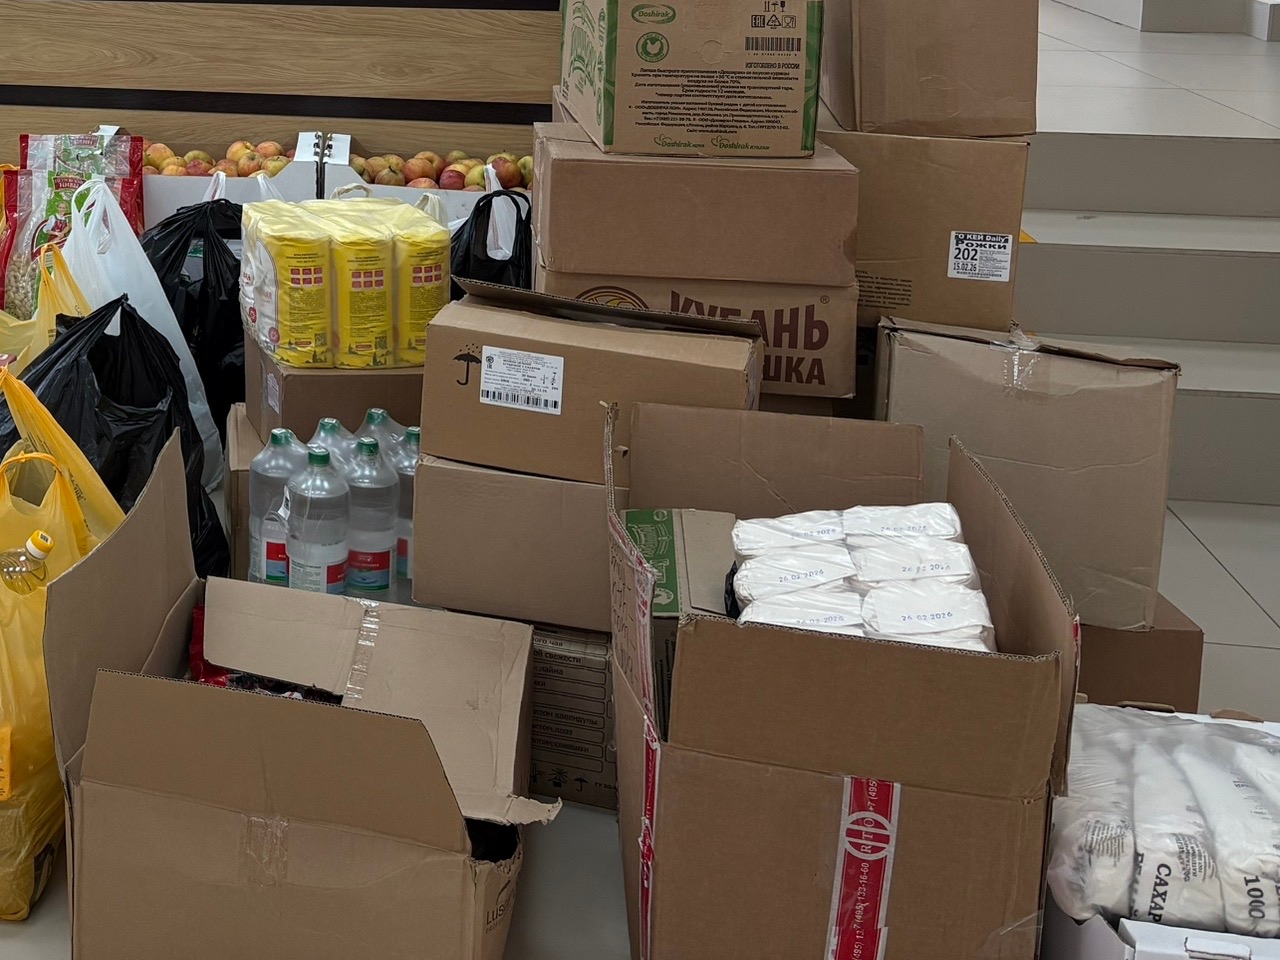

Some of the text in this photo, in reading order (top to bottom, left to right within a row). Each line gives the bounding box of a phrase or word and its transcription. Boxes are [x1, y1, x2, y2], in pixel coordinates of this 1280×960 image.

[638, 10, 671, 18] Doshirak
[955, 240, 1007, 250] Рожки
[953, 247, 978, 261] 202
[953, 262, 977, 272] 15.02.26
[930, 611, 953, 620] 2026
[545, 652, 582, 664] свежести
[857, 862, 870, 902] 133-16-60
[1147, 862, 1172, 923] САХАР
[1243, 875, 1266, 920] 1000
